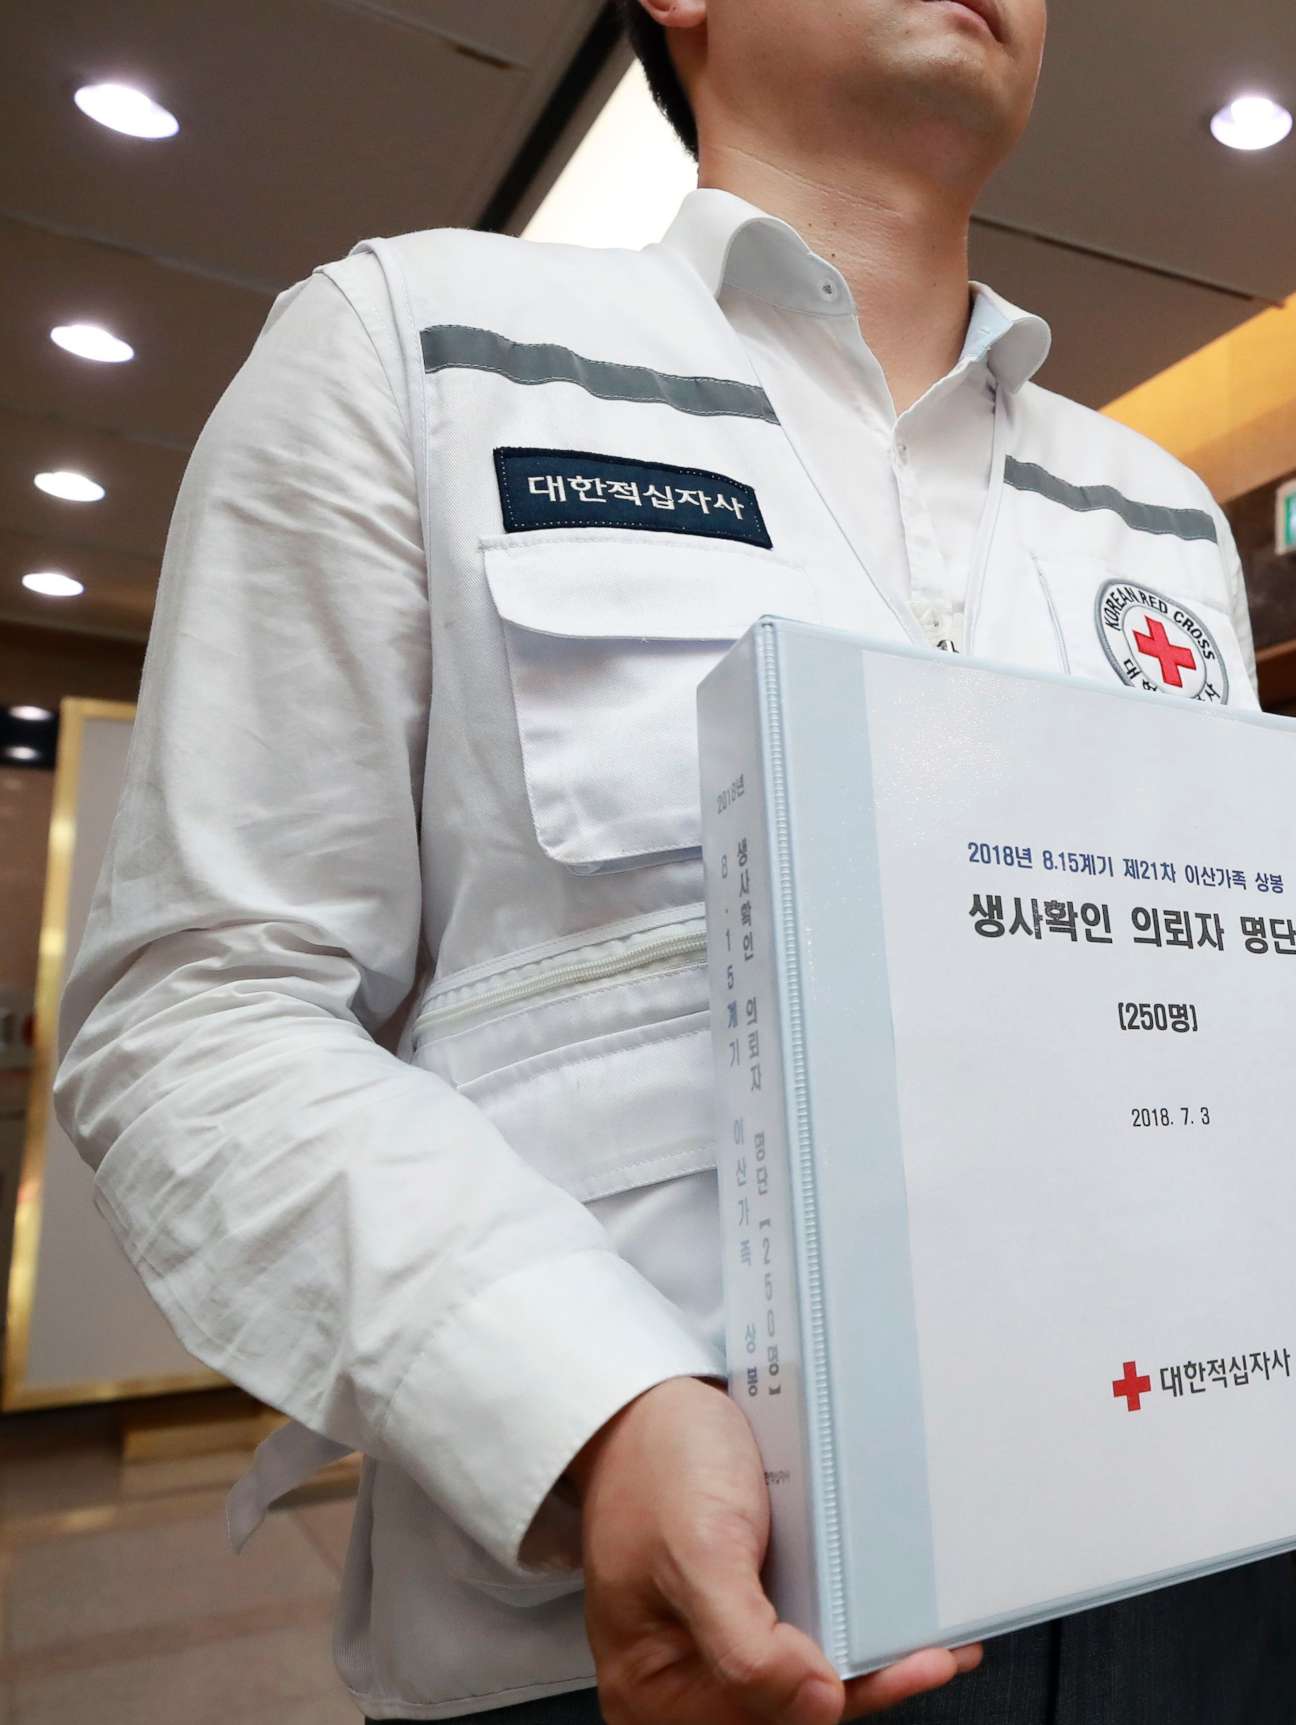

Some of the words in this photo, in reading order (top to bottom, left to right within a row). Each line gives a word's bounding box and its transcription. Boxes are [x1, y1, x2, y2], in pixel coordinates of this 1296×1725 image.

[528, 476, 744, 520] 대한적십자사
[1104, 587, 1140, 631] KOREAN
[1138, 590, 1168, 614] RED
[1173, 611, 1215, 660] CROSS
[967, 841, 1033, 870] 2018년
[1041, 849, 1115, 878] 8.15계기
[1122, 856, 1177, 884] 제21차
[1184, 863, 1248, 891] 이산가족
[1254, 871, 1285, 895] 상봉
[736, 838, 754, 962] 생사확인
[968, 893, 1113, 945] 생사확인
[1130, 906, 1225, 951] 의뢰자
[745, 1322, 759, 1398] 상봉
[1159, 1347, 1292, 1398] 대한적십자사
